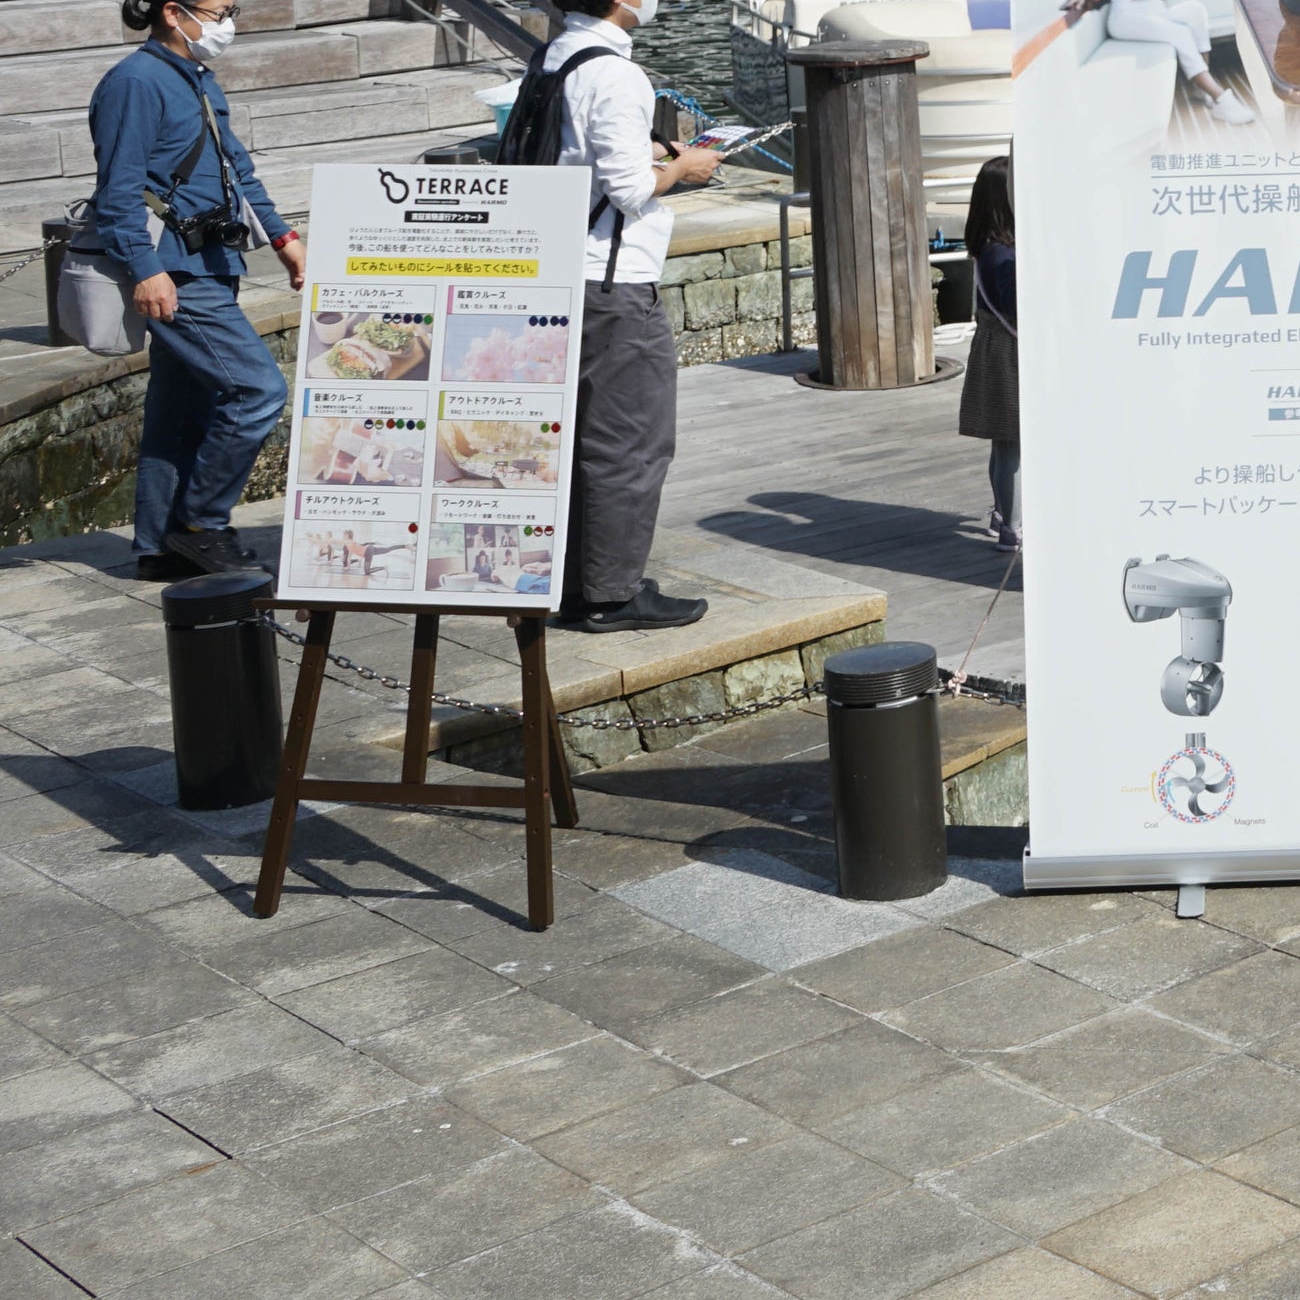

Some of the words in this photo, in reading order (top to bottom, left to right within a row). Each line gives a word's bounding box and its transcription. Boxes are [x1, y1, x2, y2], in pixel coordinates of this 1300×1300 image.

[415, 178, 509, 195] TERRACE
[350, 261, 535, 275] してみたいものにシールを貼ってください。
[1138, 332, 1181, 348] Fully
[1187, 329, 1281, 348] Integrated
[442, 499, 499, 508] ワーククルーズ
[1234, 817, 1266, 827] Magnets
